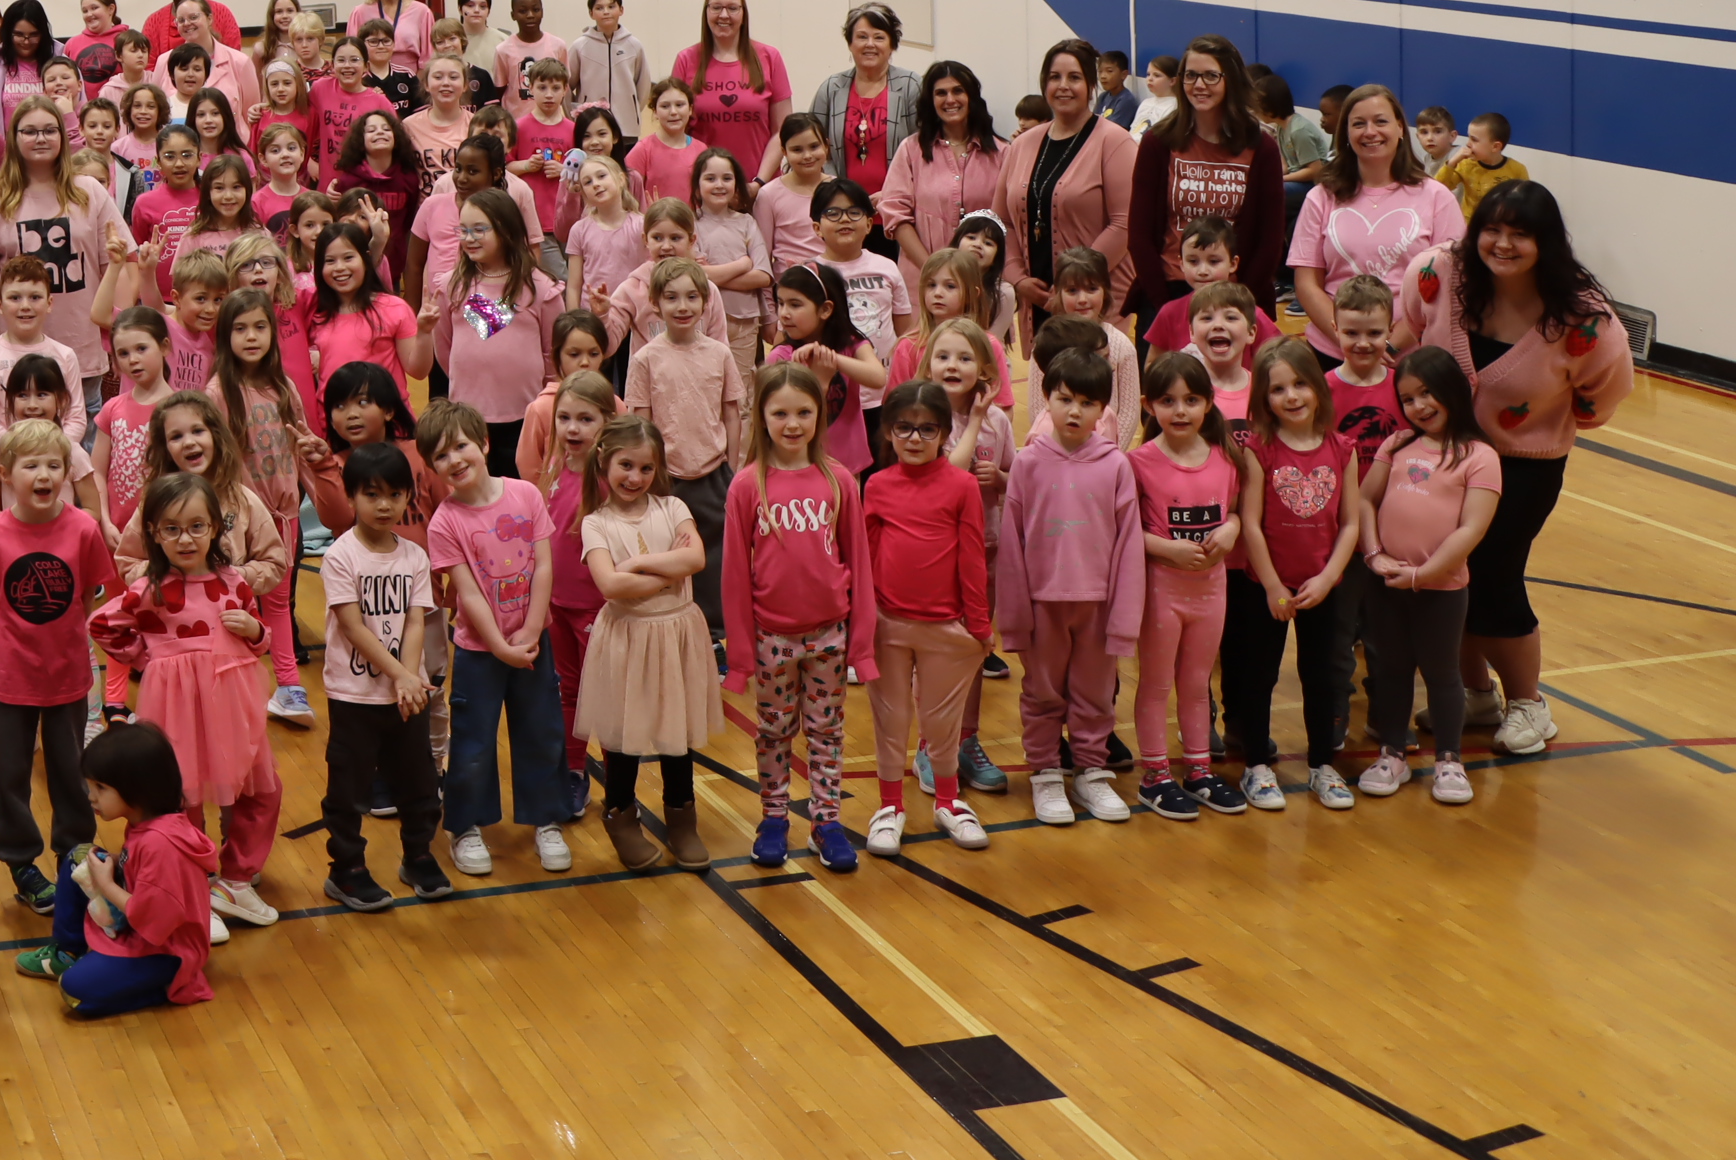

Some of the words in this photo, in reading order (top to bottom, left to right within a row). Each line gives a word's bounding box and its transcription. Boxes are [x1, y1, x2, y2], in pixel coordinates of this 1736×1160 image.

[705, 80, 751, 92] SHOW
[1179, 165, 1210, 181] Hello
[20, 223, 66, 254] be
[1379, 226, 1414, 273] kind
[1172, 511, 1192, 523] BE
[1204, 510, 1212, 522] A
[756, 497, 836, 556] sassy
[35, 560, 62, 570] COLD
[40, 570, 67, 578] LAKE
[44, 578, 71, 586] BULLY
[382, 620, 392, 635] IS
